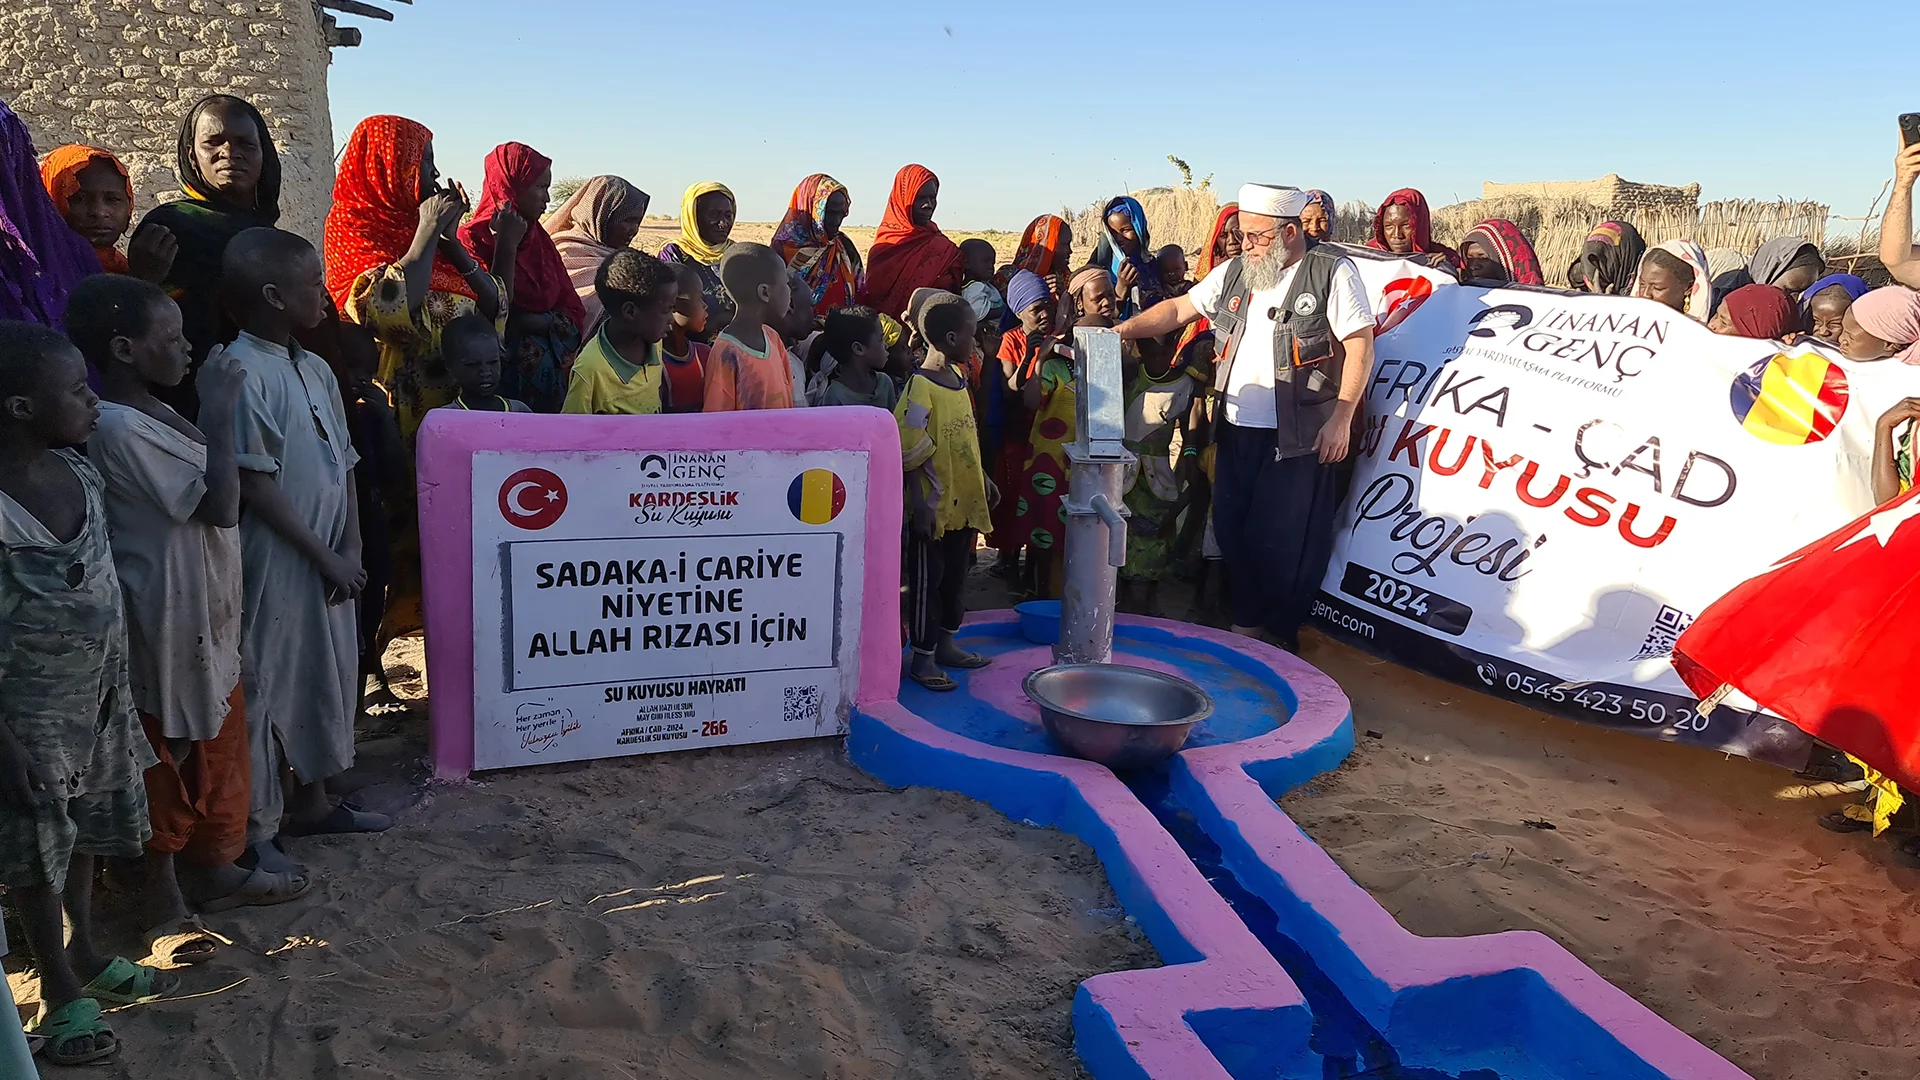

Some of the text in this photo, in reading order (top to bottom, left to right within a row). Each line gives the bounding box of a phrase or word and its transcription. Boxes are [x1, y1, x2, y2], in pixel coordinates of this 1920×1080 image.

[1546, 309, 1670, 345] İNANAN
[1522, 331, 1657, 384] GENÇ
[1365, 358, 1510, 428] FRİKA
[1573, 418, 1737, 508] ÇAD
[672, 465, 726, 481] GENÇ
[673, 453, 726, 464] İNANAN
[1387, 419, 1678, 549] KUYUSU
[634, 502, 734, 528] Su Kuyusu
[1350, 473, 1547, 582] Projesi
[535, 548, 804, 590] SADAKA-İ CARİYE
[601, 584, 744, 620] NİYETİNE
[1364, 572, 1431, 617] 2024
[527, 612, 808, 659] ALLAH RIZASI İÇİN
[604, 677, 746, 703] SU KUYUSU HAYRATI
[1505, 671, 1710, 732] 0545 423 50 20
[516, 715, 531, 724] Her
[701, 719, 729, 737] 266
